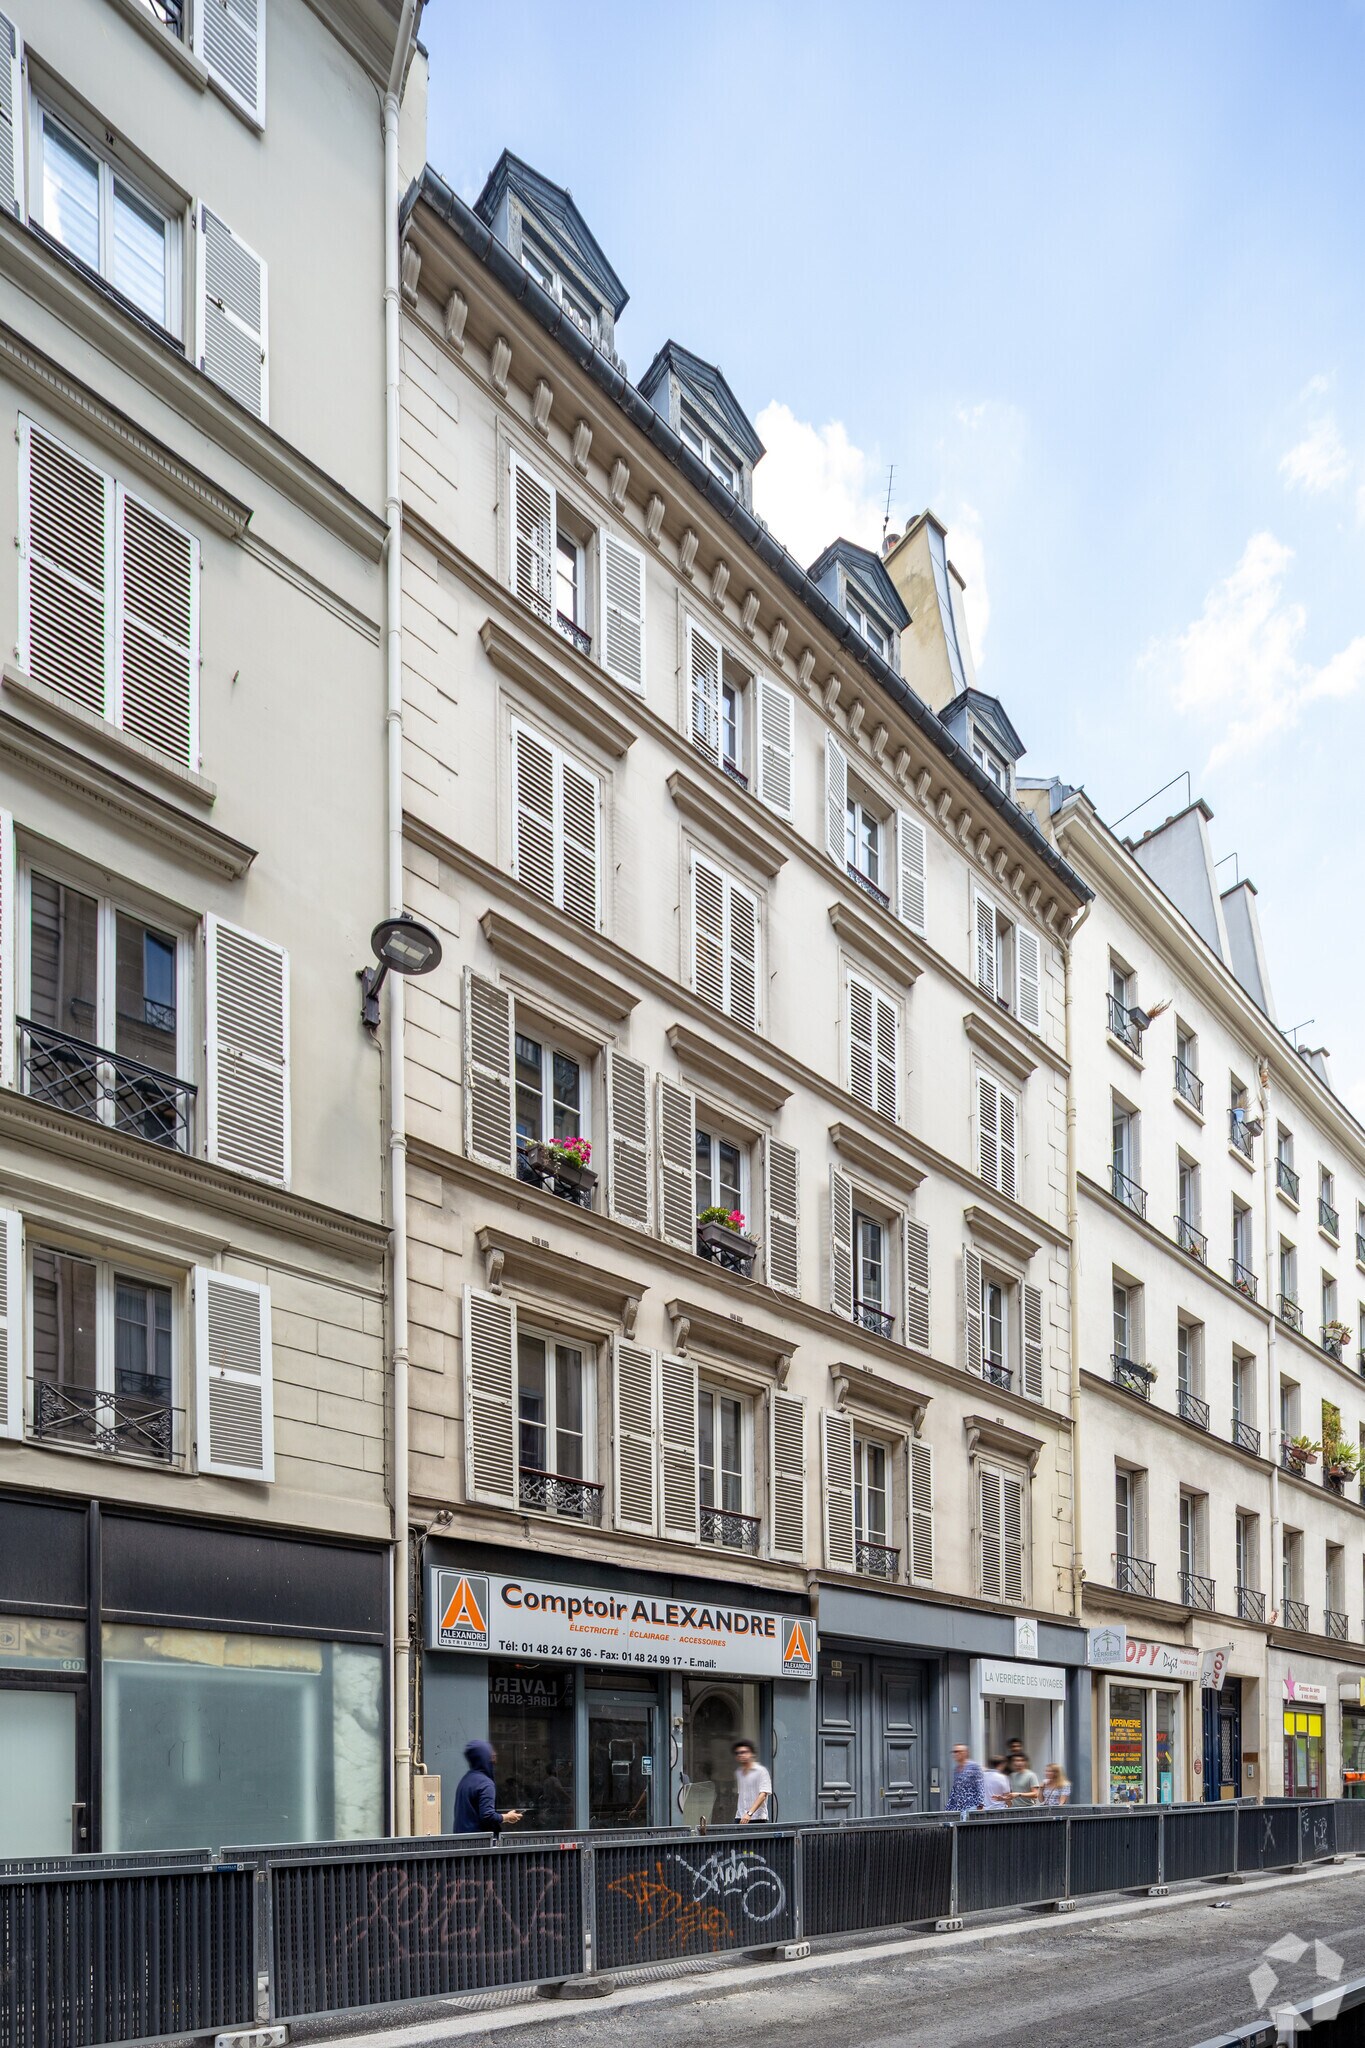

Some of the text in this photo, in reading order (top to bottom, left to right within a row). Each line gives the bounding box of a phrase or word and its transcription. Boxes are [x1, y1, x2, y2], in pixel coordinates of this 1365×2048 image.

[501, 1583, 775, 1638] Comptoir ALEXANDRE
[441, 1639, 487, 1647] DISTRIBUTION
[442, 1630, 486, 1640] ALEXANDRE
[569, 1623, 619, 1636] ÉLECTRICITÉ
[629, 1629, 670, 1641] ÉCLAIRAGE
[679, 1636, 726, 1647] ACCESSOIRES
[499, 1640, 518, 1651] Tél:
[521, 1643, 533, 1652] 01
[536, 1644, 549, 1654] 48
[551, 1645, 563, 1655] 24
[566, 1646, 577, 1657] 67
[580, 1648, 592, 1658] 36
[600, 1650, 619, 1660] Fax:
[622, 1652, 632, 1661] 01
[634, 1653, 645, 1662] 48
[647, 1654, 657, 1664] 24
[660, 1656, 670, 1665] 99
[672, 1657, 682, 1666] 17
[690, 1658, 717, 1668] E.mail:
[1126, 1641, 1160, 1665] OPY
[985, 1672, 1063, 1688] LA VERRIÈRE DES VOYAGES
[1212, 1651, 1224, 1688] COPY
[1110, 1719, 1141, 1728] MPRIMERIE
